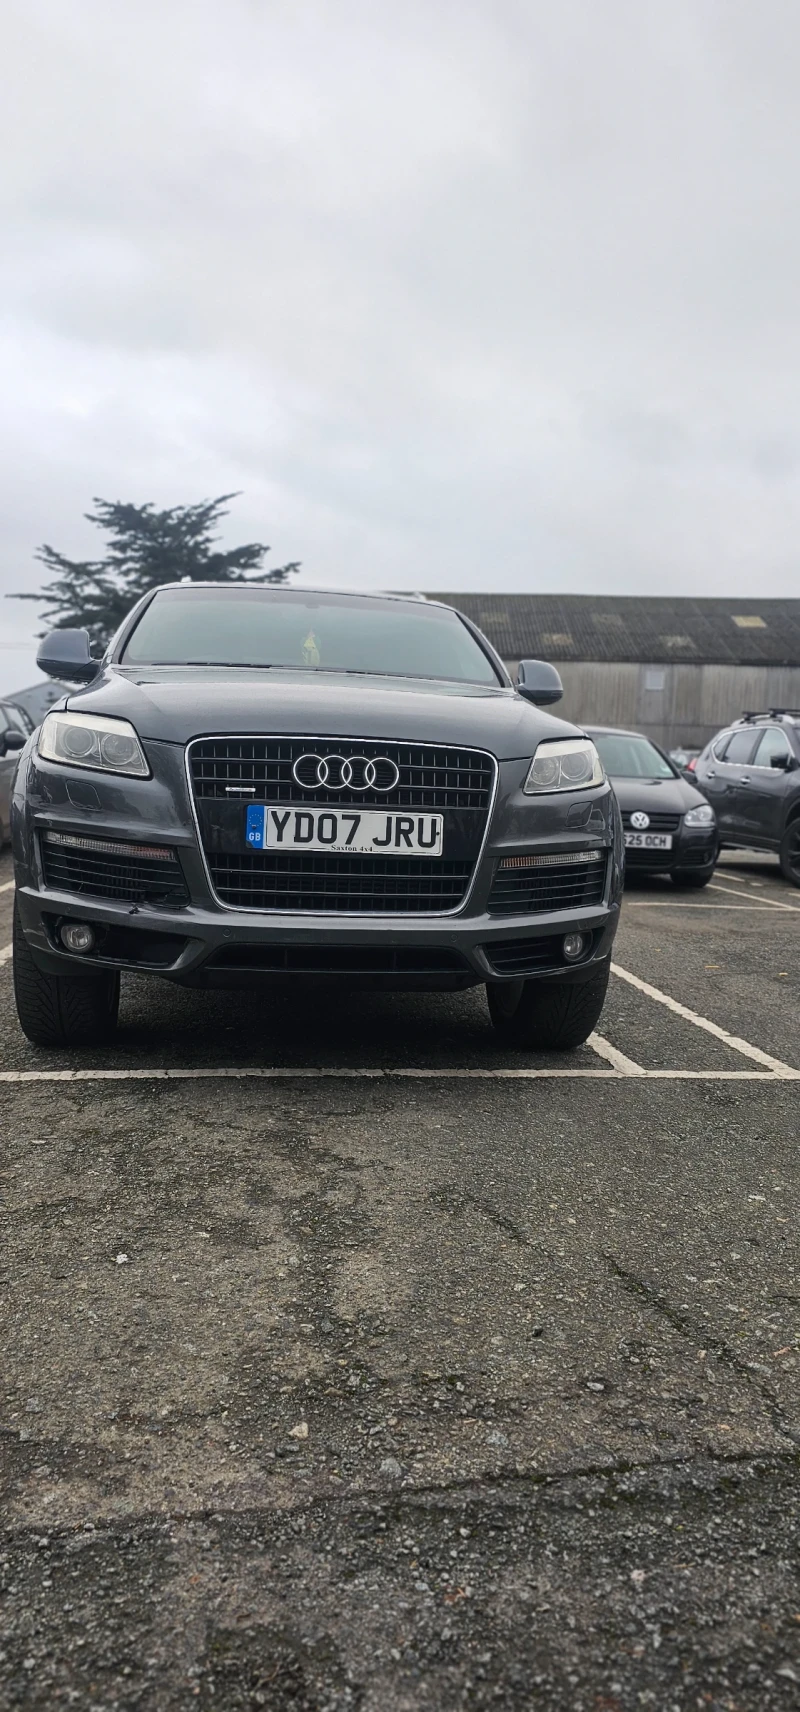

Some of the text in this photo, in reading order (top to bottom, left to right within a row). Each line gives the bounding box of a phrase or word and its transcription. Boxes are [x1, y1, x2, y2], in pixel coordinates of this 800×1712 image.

[271, 811, 437, 848] YD07 JRU
[248, 832, 261, 841] GB
[331, 844, 357, 852] Saxton
